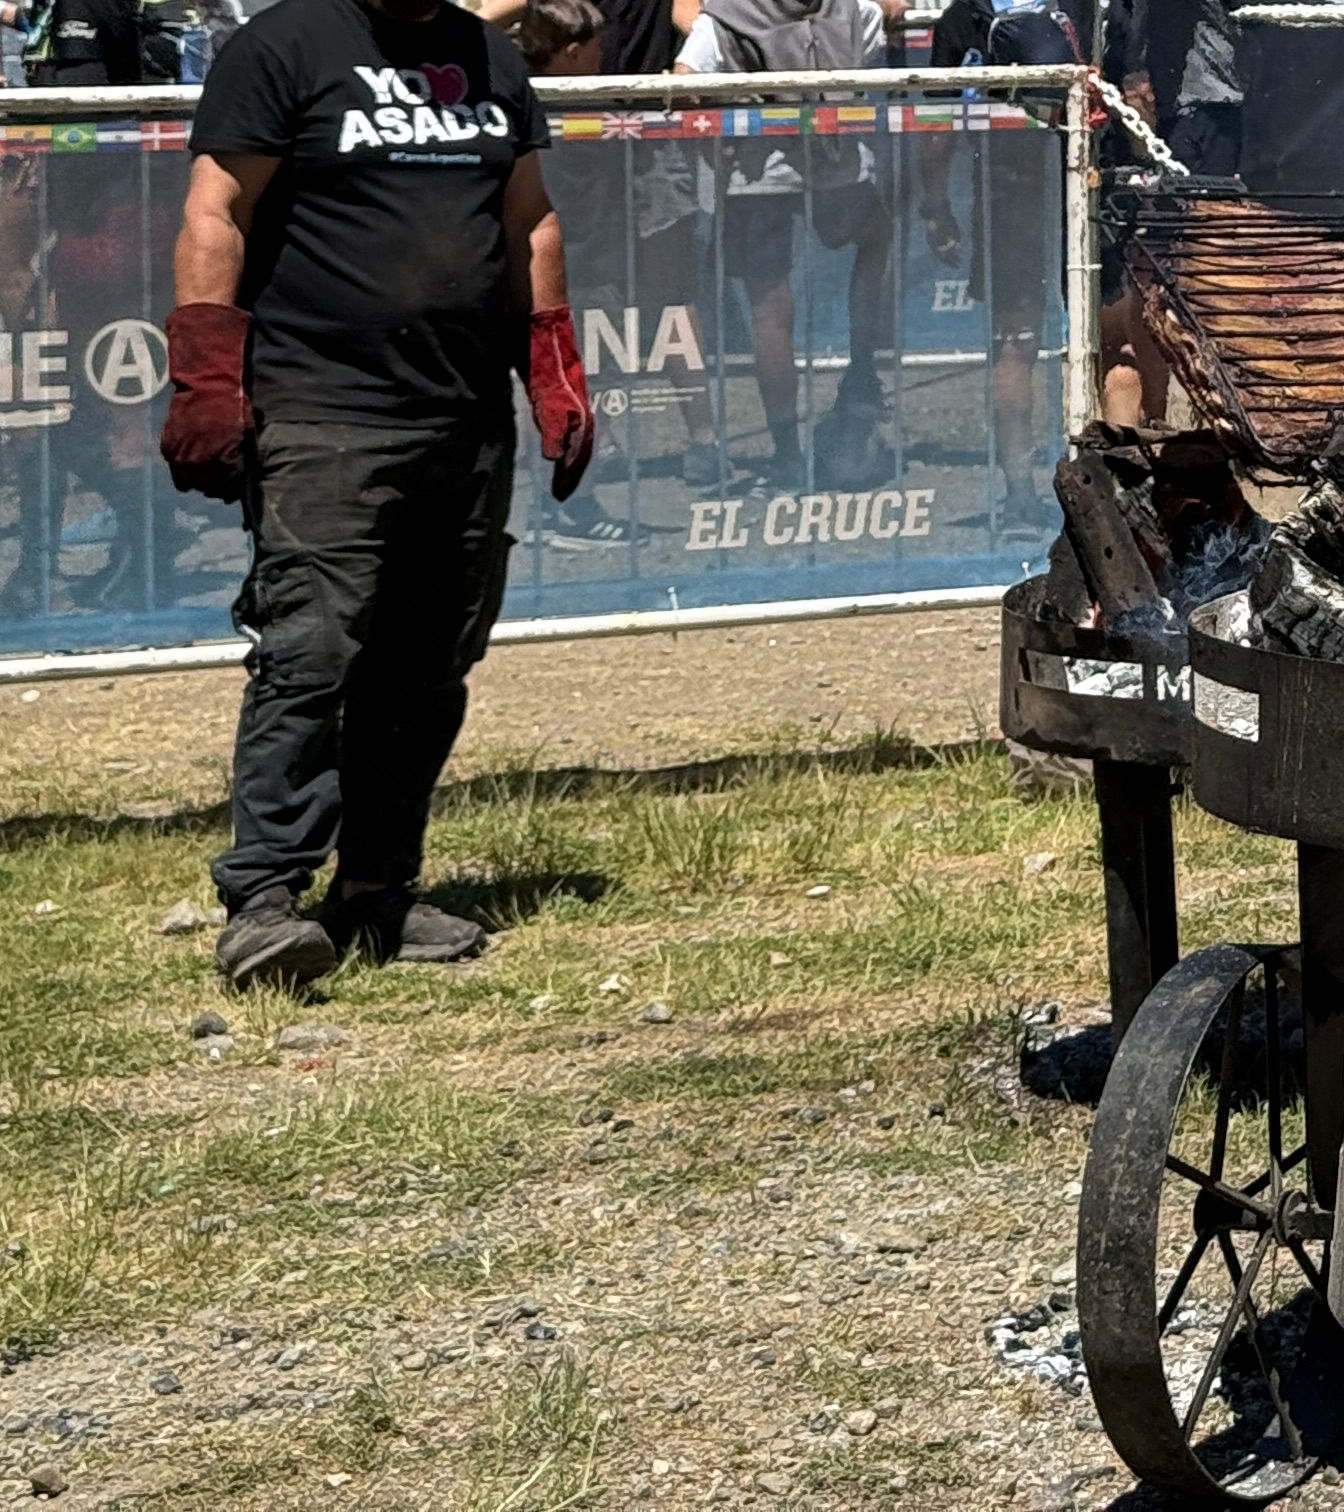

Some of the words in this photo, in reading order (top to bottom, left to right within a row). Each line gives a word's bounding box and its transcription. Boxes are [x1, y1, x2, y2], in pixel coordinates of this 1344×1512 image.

[353, 65, 432, 105] YO
[338, 101, 509, 153] ASADO
[685, 499, 750, 551] EL
[763, 488, 936, 546] CRUCE
